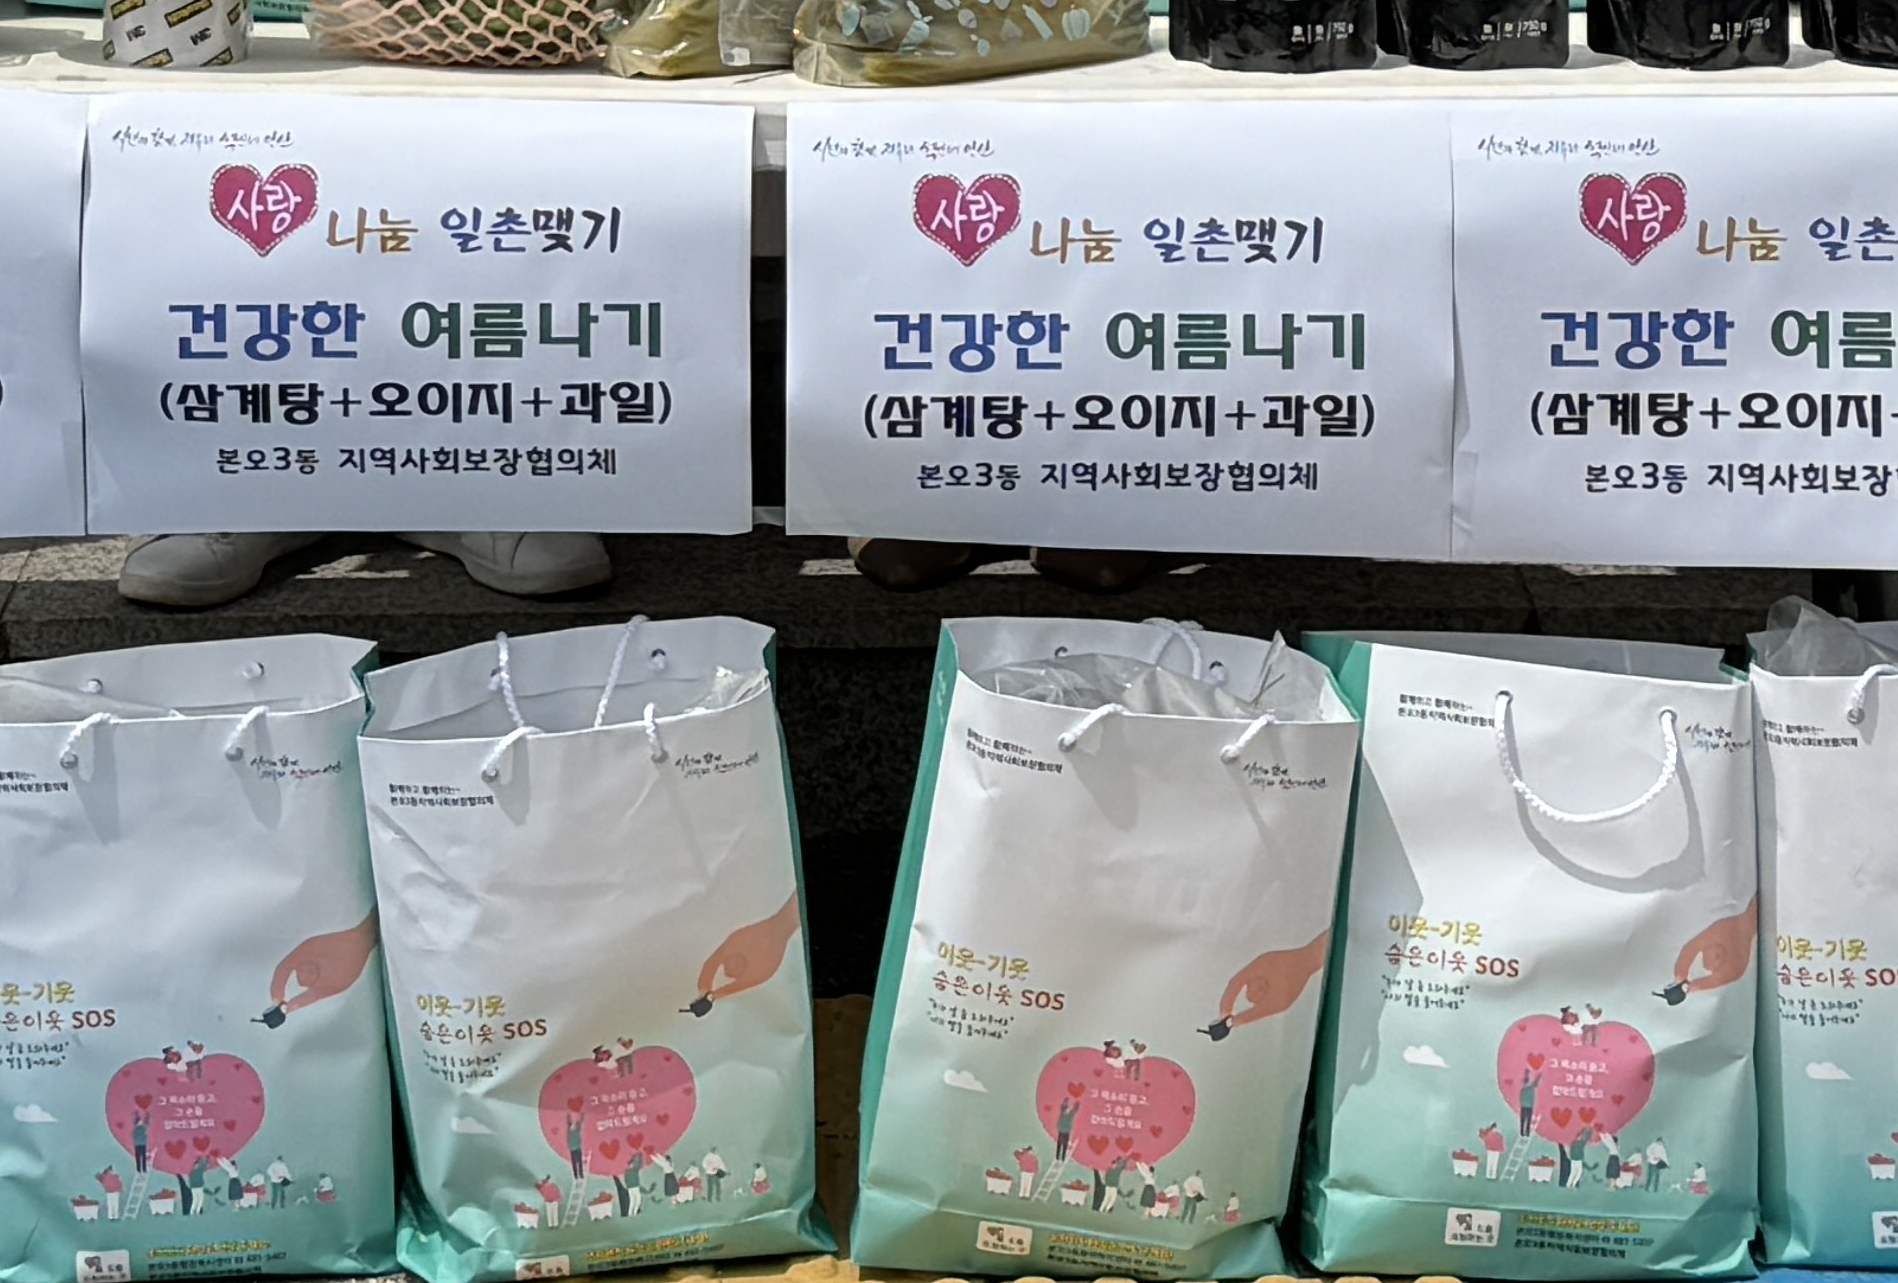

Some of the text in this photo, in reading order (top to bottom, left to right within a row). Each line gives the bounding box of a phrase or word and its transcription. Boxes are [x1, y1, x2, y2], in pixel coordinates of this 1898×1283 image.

[226, 179, 621, 254] 사랑 나눔 일촌맺기
[929, 188, 1324, 265] 사랑 나눔 일촌맺기
[1597, 188, 1672, 244] 사랑
[1696, 216, 1788, 263] 나눔
[168, 300, 661, 362] 건강한 여름나기
[874, 310, 1365, 374] 건강한 여름나기
[1540, 308, 1735, 370] 건강한
[160, 380, 672, 426] (삼계탕+오이지+과일)
[864, 393, 1375, 440] (삼계탕+오이지+과일)
[216, 446, 617, 477] 본오3동 지역사회보장협의체
[916, 460, 1318, 493] 본오3동 지역사회보장협의체
[1585, 462, 1688, 495] 본오3동
[1475, 956, 1520, 978] SOS
[71, 1009, 117, 1030] SOS
[1020, 989, 1066, 1012] SOS
[503, 1018, 548, 1040] SOS
